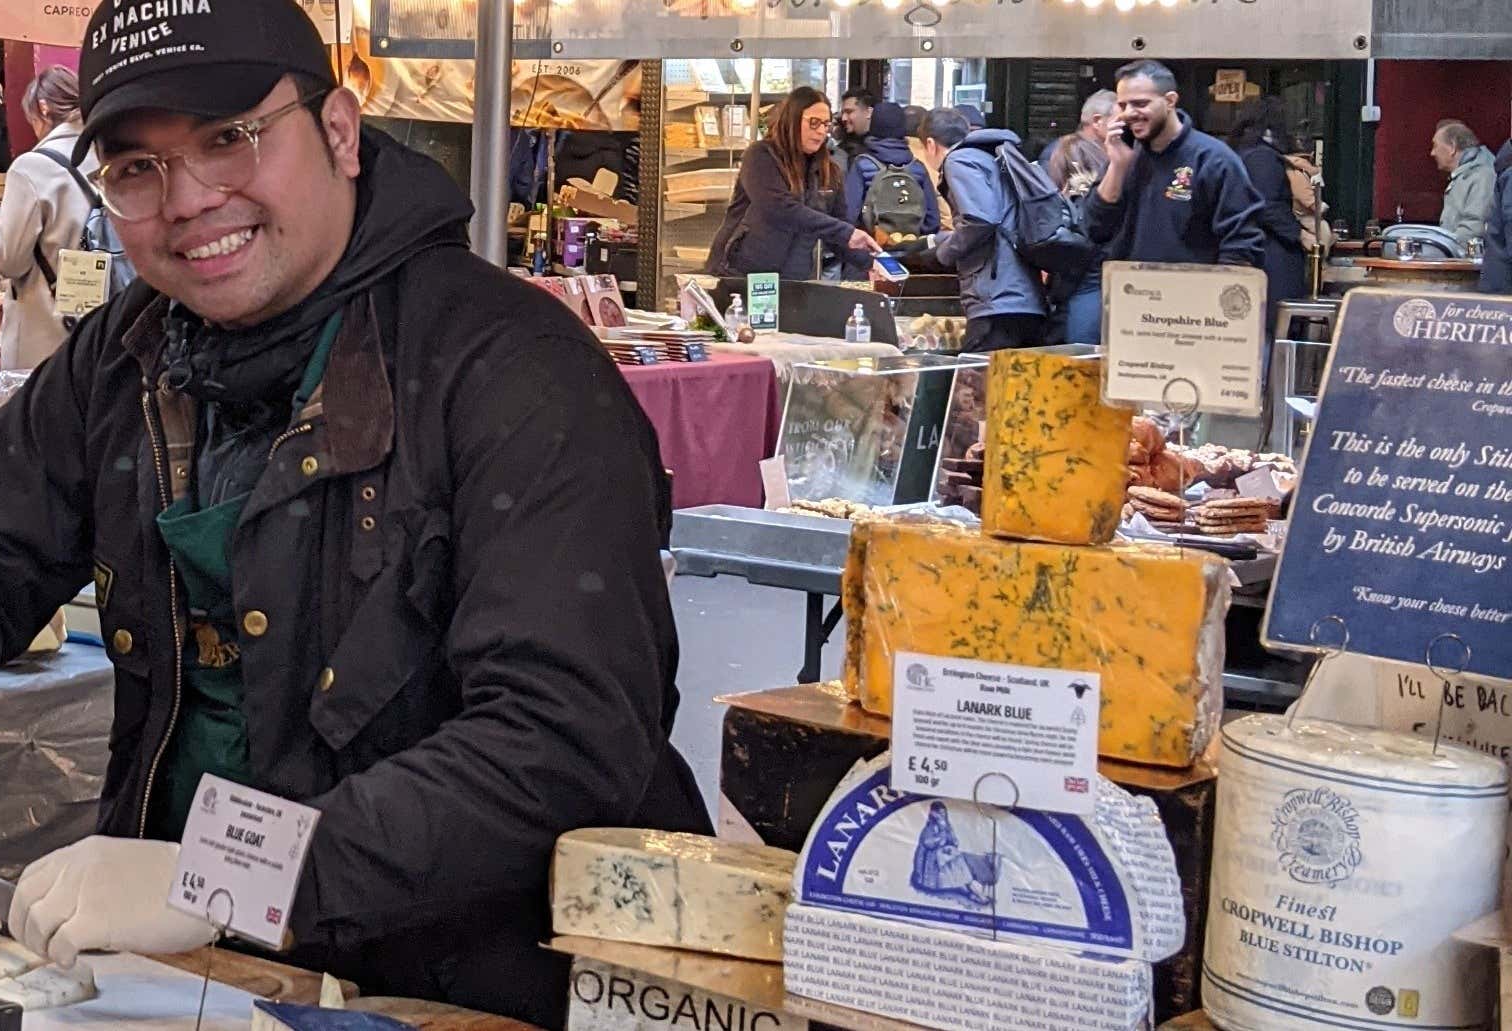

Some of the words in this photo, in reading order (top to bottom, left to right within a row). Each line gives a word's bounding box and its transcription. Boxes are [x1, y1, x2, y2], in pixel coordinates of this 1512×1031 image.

[92, 22, 107, 49] EX
[113, 0, 211, 33] MACHINA
[110, 21, 173, 54] VENICE
[556, 65, 581, 76] 2006
[1141, 313, 1201, 327] Shropshire
[1204, 316, 1229, 328] Blue
[1441, 302, 1464, 321] for
[1465, 304, 1512, 320] cheese-
[1372, 370, 1425, 390] fastest
[1427, 373, 1474, 392] cheese
[1475, 377, 1493, 394] in
[1330, 430, 1372, 453] This
[1374, 436, 1393, 456] is
[1396, 437, 1426, 459] the
[1430, 442, 1471, 468] only
[1344, 467, 1363, 484] to
[1367, 466, 1386, 487] be
[1392, 475, 1454, 495] served
[1455, 482, 1479, 498] on
[1483, 481, 1512, 502] the
[1312, 493, 1396, 521] Concorde
[1399, 503, 1505, 534] Supersonic
[1323, 527, 1346, 553] by
[1348, 529, 1416, 557] British
[1417, 540, 1507, 573] Airways
[1390, 595, 1427, 610] your
[1428, 597, 1467, 617] cheese
[976, 671, 1001, 682] Cheese
[980, 684, 994, 692] Raw
[1398, 673, 1426, 699] I'LL
[1444, 679, 1465, 708] BE
[1476, 685, 1512, 717] BAC
[957, 699, 1001, 717] LANARK
[1004, 706, 1032, 720] BLUE
[915, 775, 929, 785] 100
[226, 824, 245, 842] BLUE
[244, 830, 266, 848] GOAT
[1276, 894, 1337, 921] Finest
[1222, 897, 1315, 940] CROPWELL
[1320, 931, 1403, 956] BISHOP
[1239, 929, 1279, 953] BLUE
[574, 969, 781, 1031] ORGANIC
